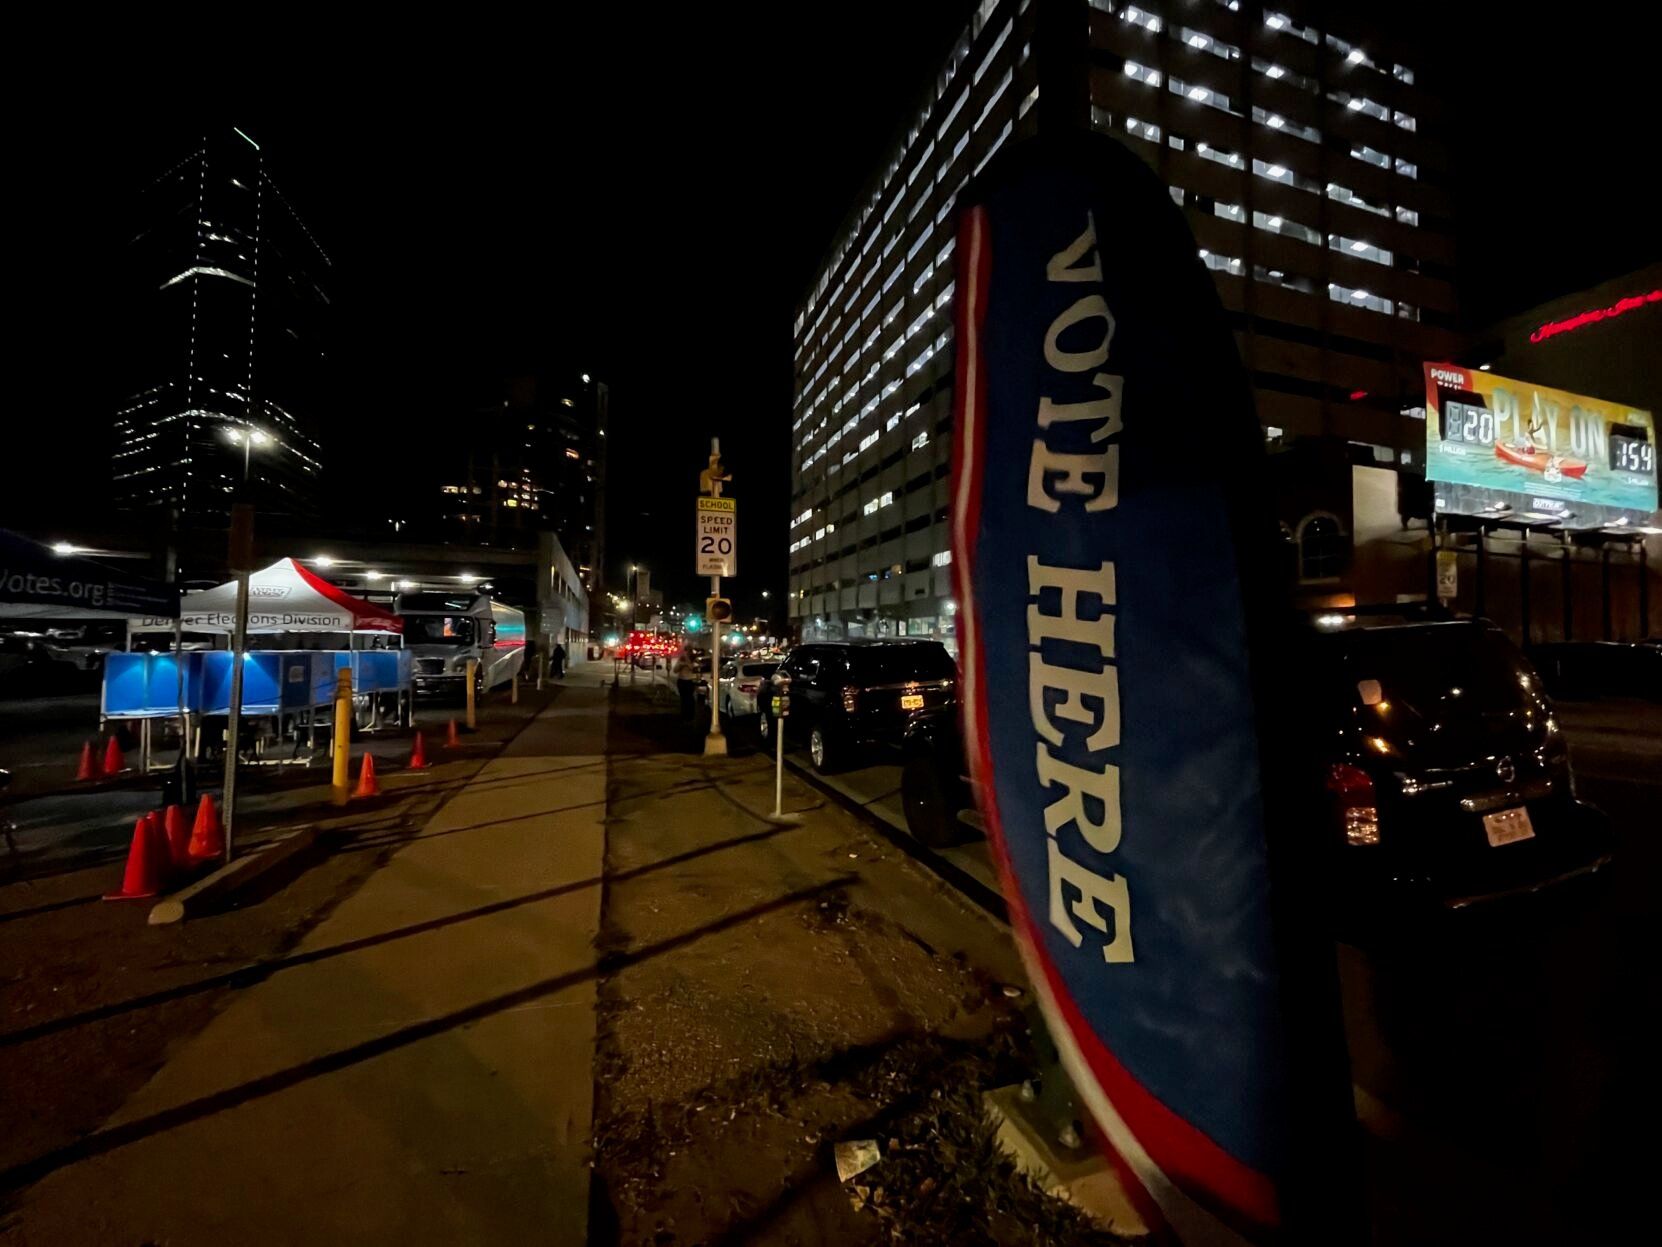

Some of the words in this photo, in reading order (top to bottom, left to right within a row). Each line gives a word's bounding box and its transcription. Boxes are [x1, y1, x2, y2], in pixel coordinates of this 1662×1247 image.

[1027, 208, 1124, 513] VOTE
[1431, 368, 1464, 384] POWER
[1463, 409, 1494, 443] 20
[1493, 388, 1559, 450] PLAY
[1570, 406, 1606, 458] ON
[700, 500, 733, 510] SCHOOL
[700, 516, 732, 525] SPEED
[704, 526, 728, 534] LIMIT
[701, 536, 731, 554] 20
[207, 613, 278, 626] Elecons
[283, 613, 341, 626] Division
[1027, 555, 1135, 964] HERE
